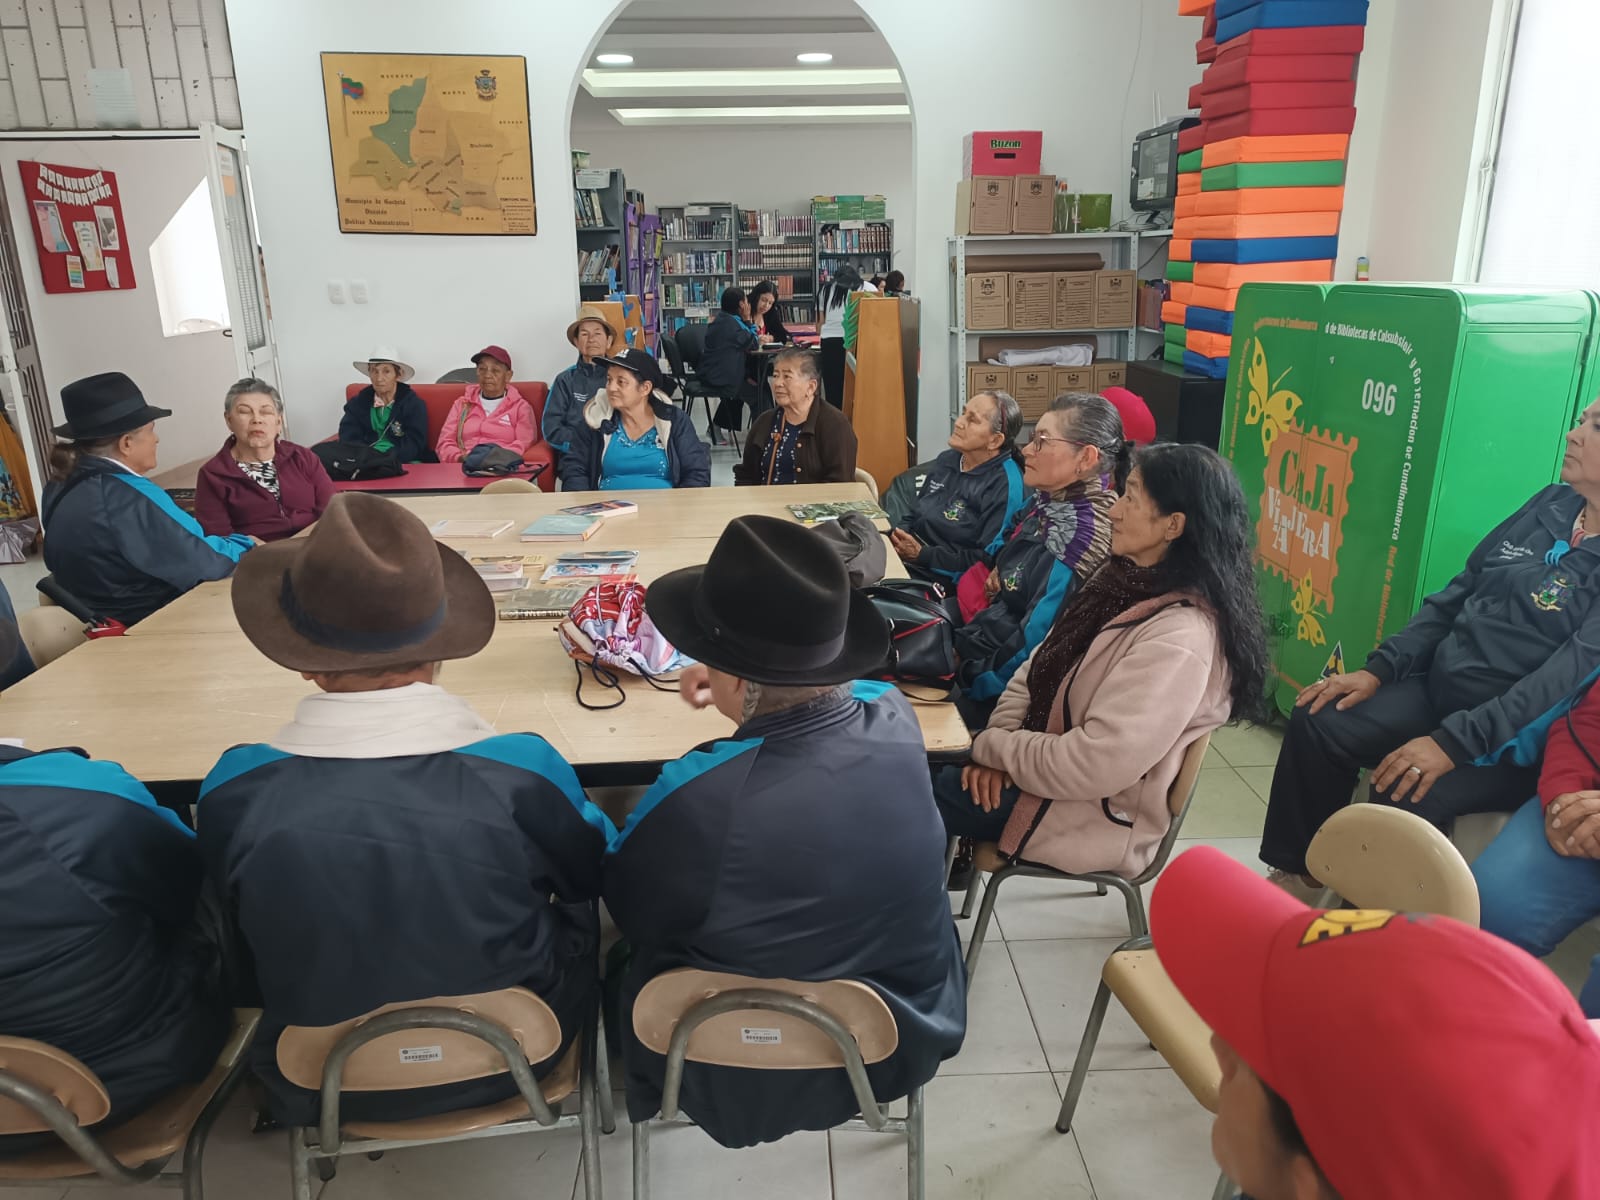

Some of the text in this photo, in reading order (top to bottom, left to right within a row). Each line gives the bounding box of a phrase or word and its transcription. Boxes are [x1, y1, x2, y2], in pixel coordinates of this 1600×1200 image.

[1329, 323, 1337, 336] de
[1337, 323, 1369, 341] Bibliotecas
[1369, 328, 1377, 342] de
[1409, 357, 1418, 370] y
[1361, 378, 1398, 417] 096
[1278, 449, 1335, 518] CAJA
[1391, 461, 1412, 541] Cundinamarca
